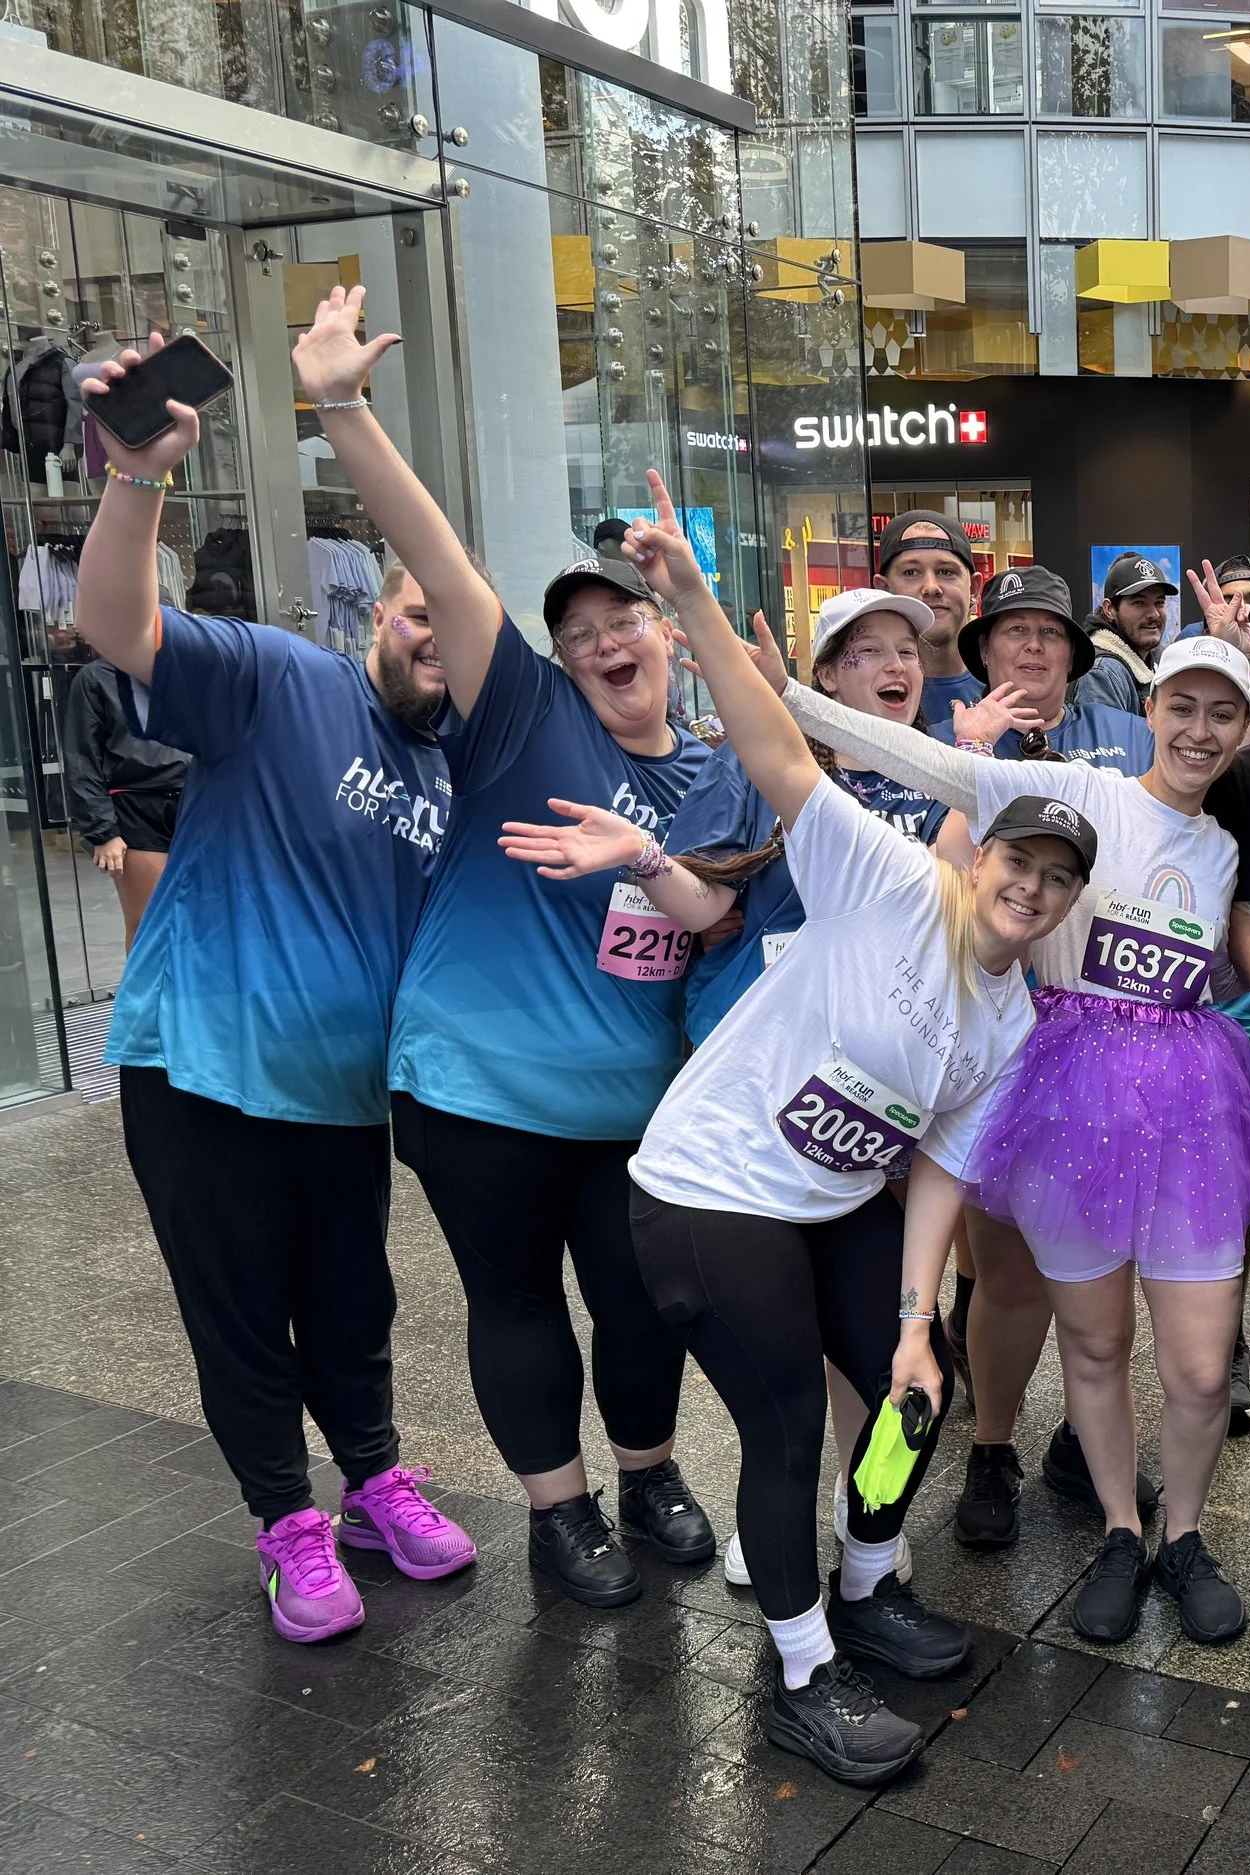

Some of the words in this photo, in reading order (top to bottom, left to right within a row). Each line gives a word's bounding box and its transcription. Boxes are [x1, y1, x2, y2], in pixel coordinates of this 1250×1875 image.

[793, 404, 955, 450] swatch
[961, 521, 989, 539] WAVE
[335, 782, 379, 821] FOR
[1108, 900, 1127, 912] hbf
[1132, 905, 1152, 920] run
[1125, 913, 1150, 925] REASON
[1171, 921, 1202, 936] Specsavers
[637, 966, 666, 977] 12km
[673, 966, 680, 975] D
[1096, 932, 1206, 990] 16377
[1116, 975, 1151, 994] 12km
[1163, 988, 1173, 1000] C
[894, 955, 924, 994] THE
[924, 997, 961, 1049] ALIYA
[888, 988, 965, 1092] FOUNDATION
[844, 1084, 869, 1104] REASON
[853, 1080, 875, 1099] run
[888, 1105, 917, 1126] Specsavers
[785, 1093, 904, 1169] 20034
[802, 1140, 835, 1165] 12km
[841, 1162, 853, 1172] C
